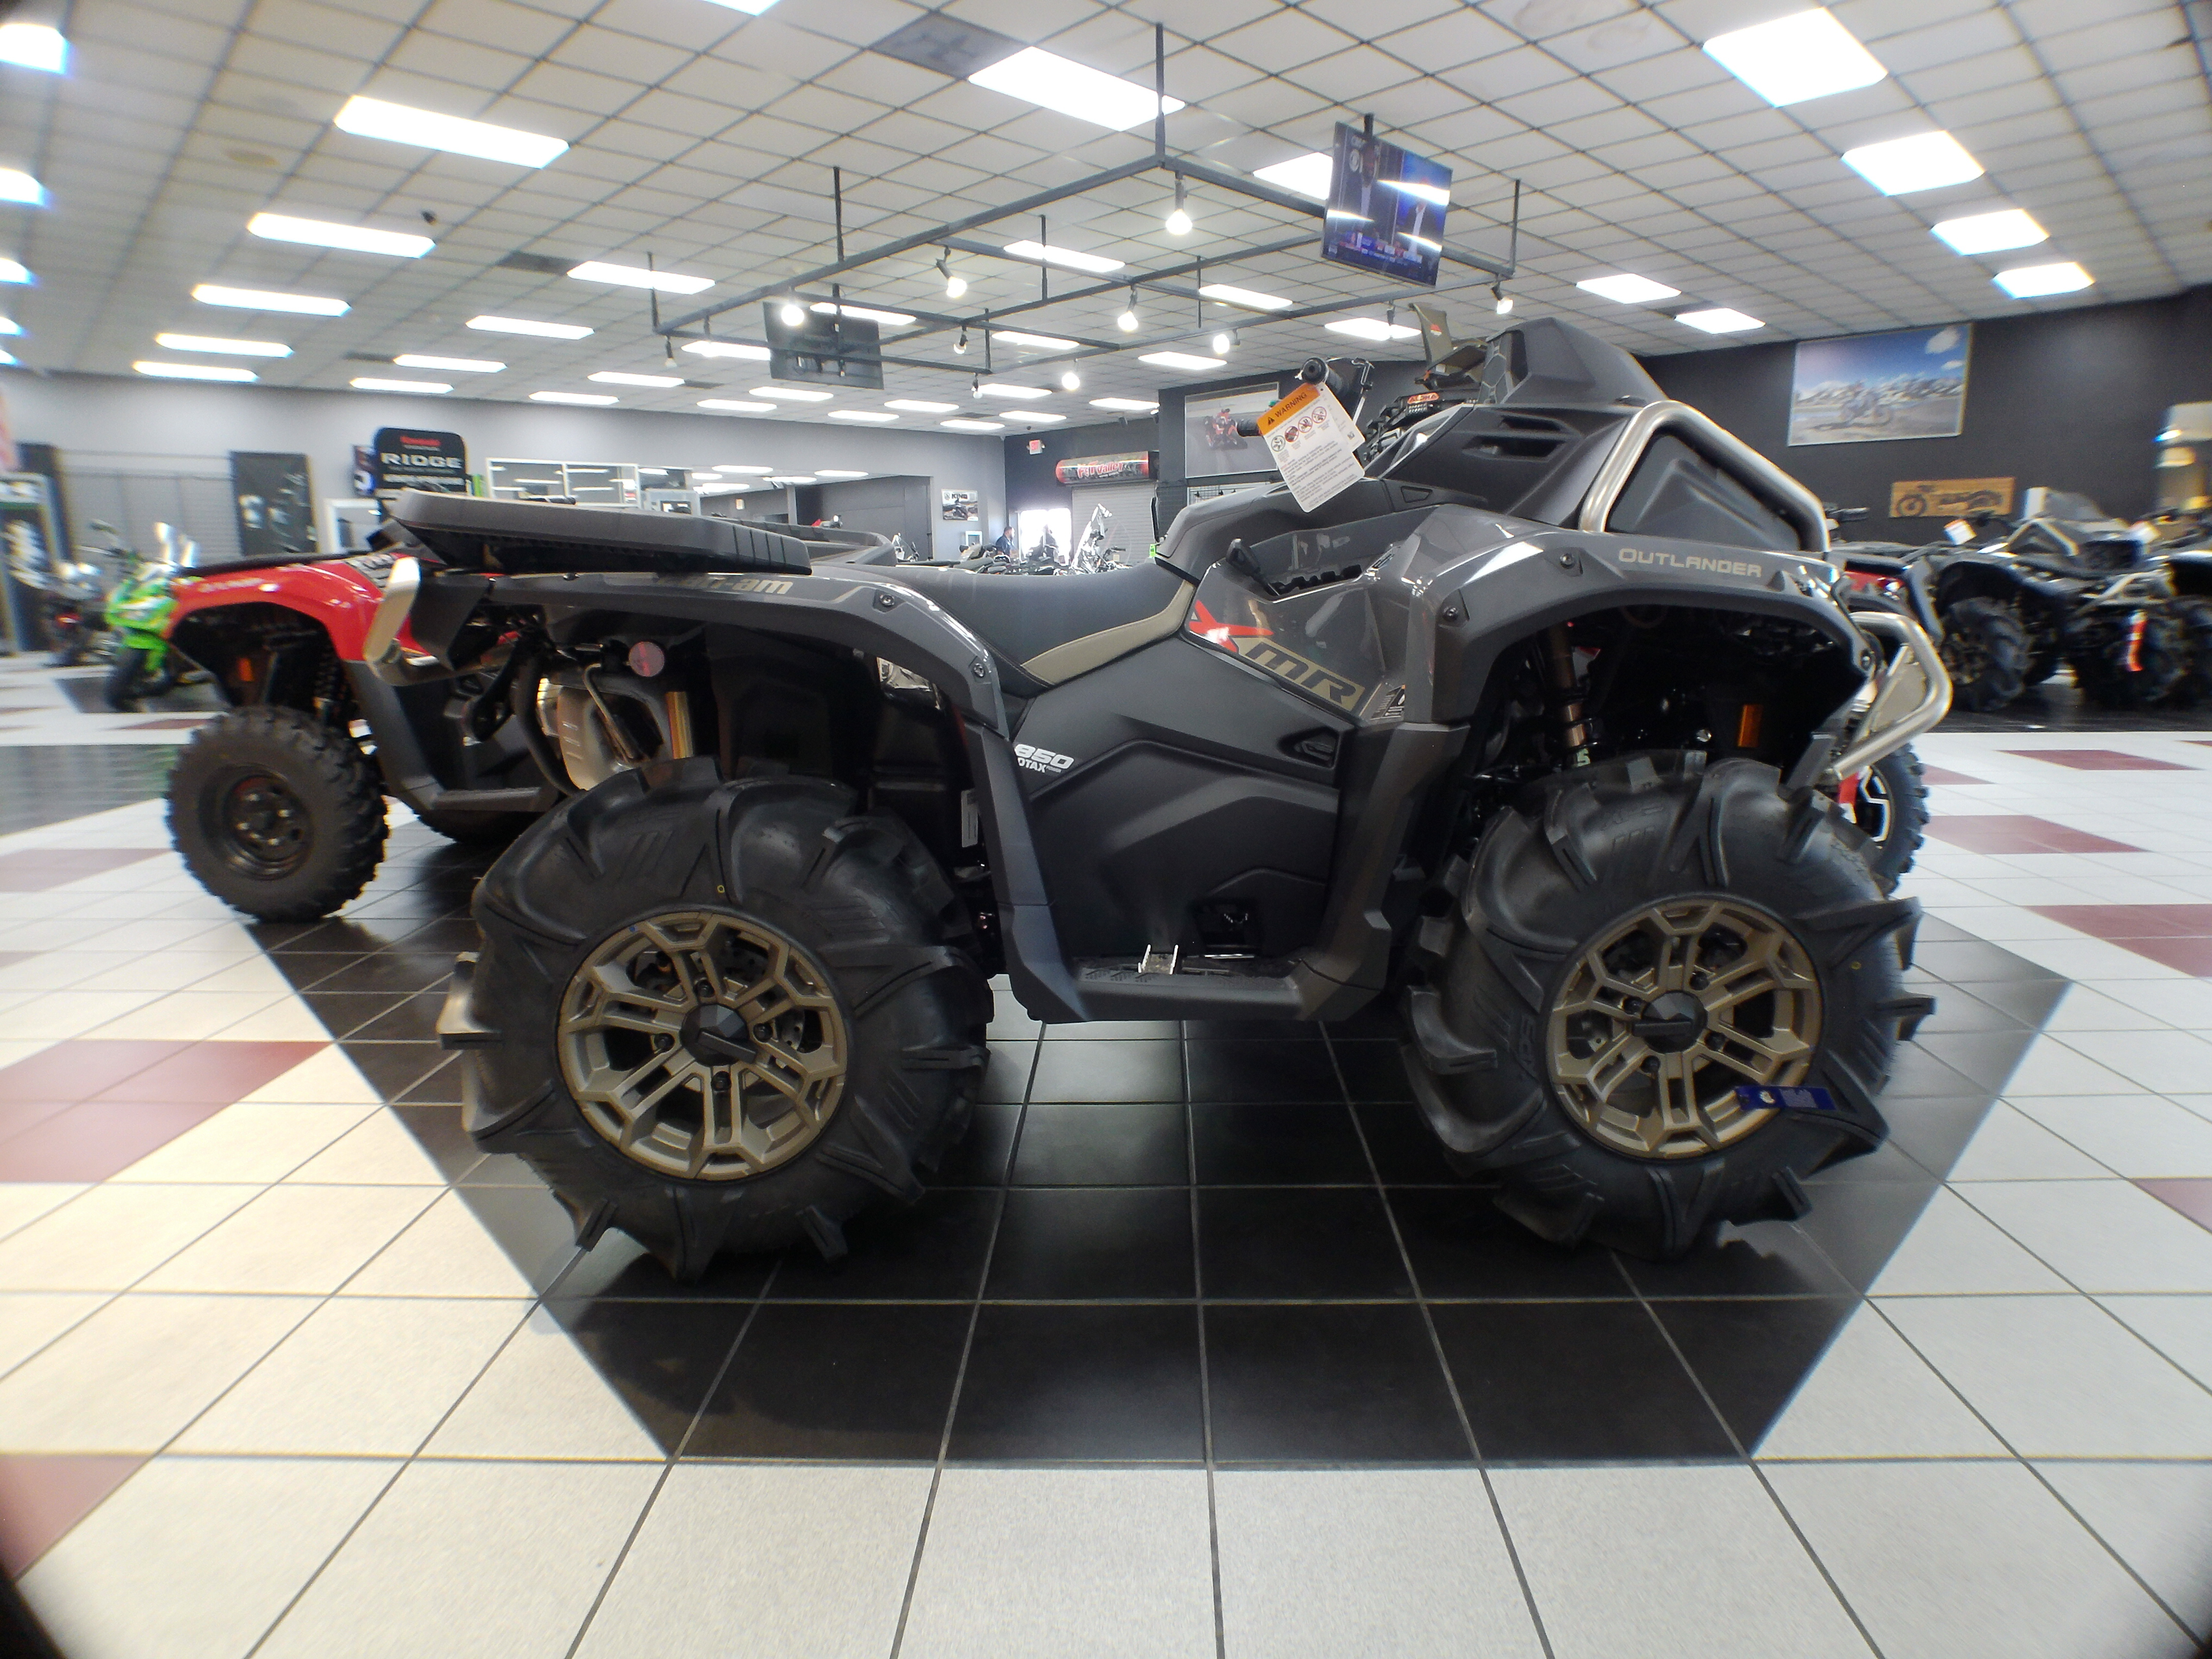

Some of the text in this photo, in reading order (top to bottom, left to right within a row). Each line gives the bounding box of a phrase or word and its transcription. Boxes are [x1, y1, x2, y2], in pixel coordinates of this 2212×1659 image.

[1274, 392, 1307, 418] WARNING
[380, 453, 462, 469] RIDGE
[1619, 547, 1762, 578] OUTLANDER
[1014, 743, 1074, 769] 850
[1017, 757, 1047, 773] OTAX
